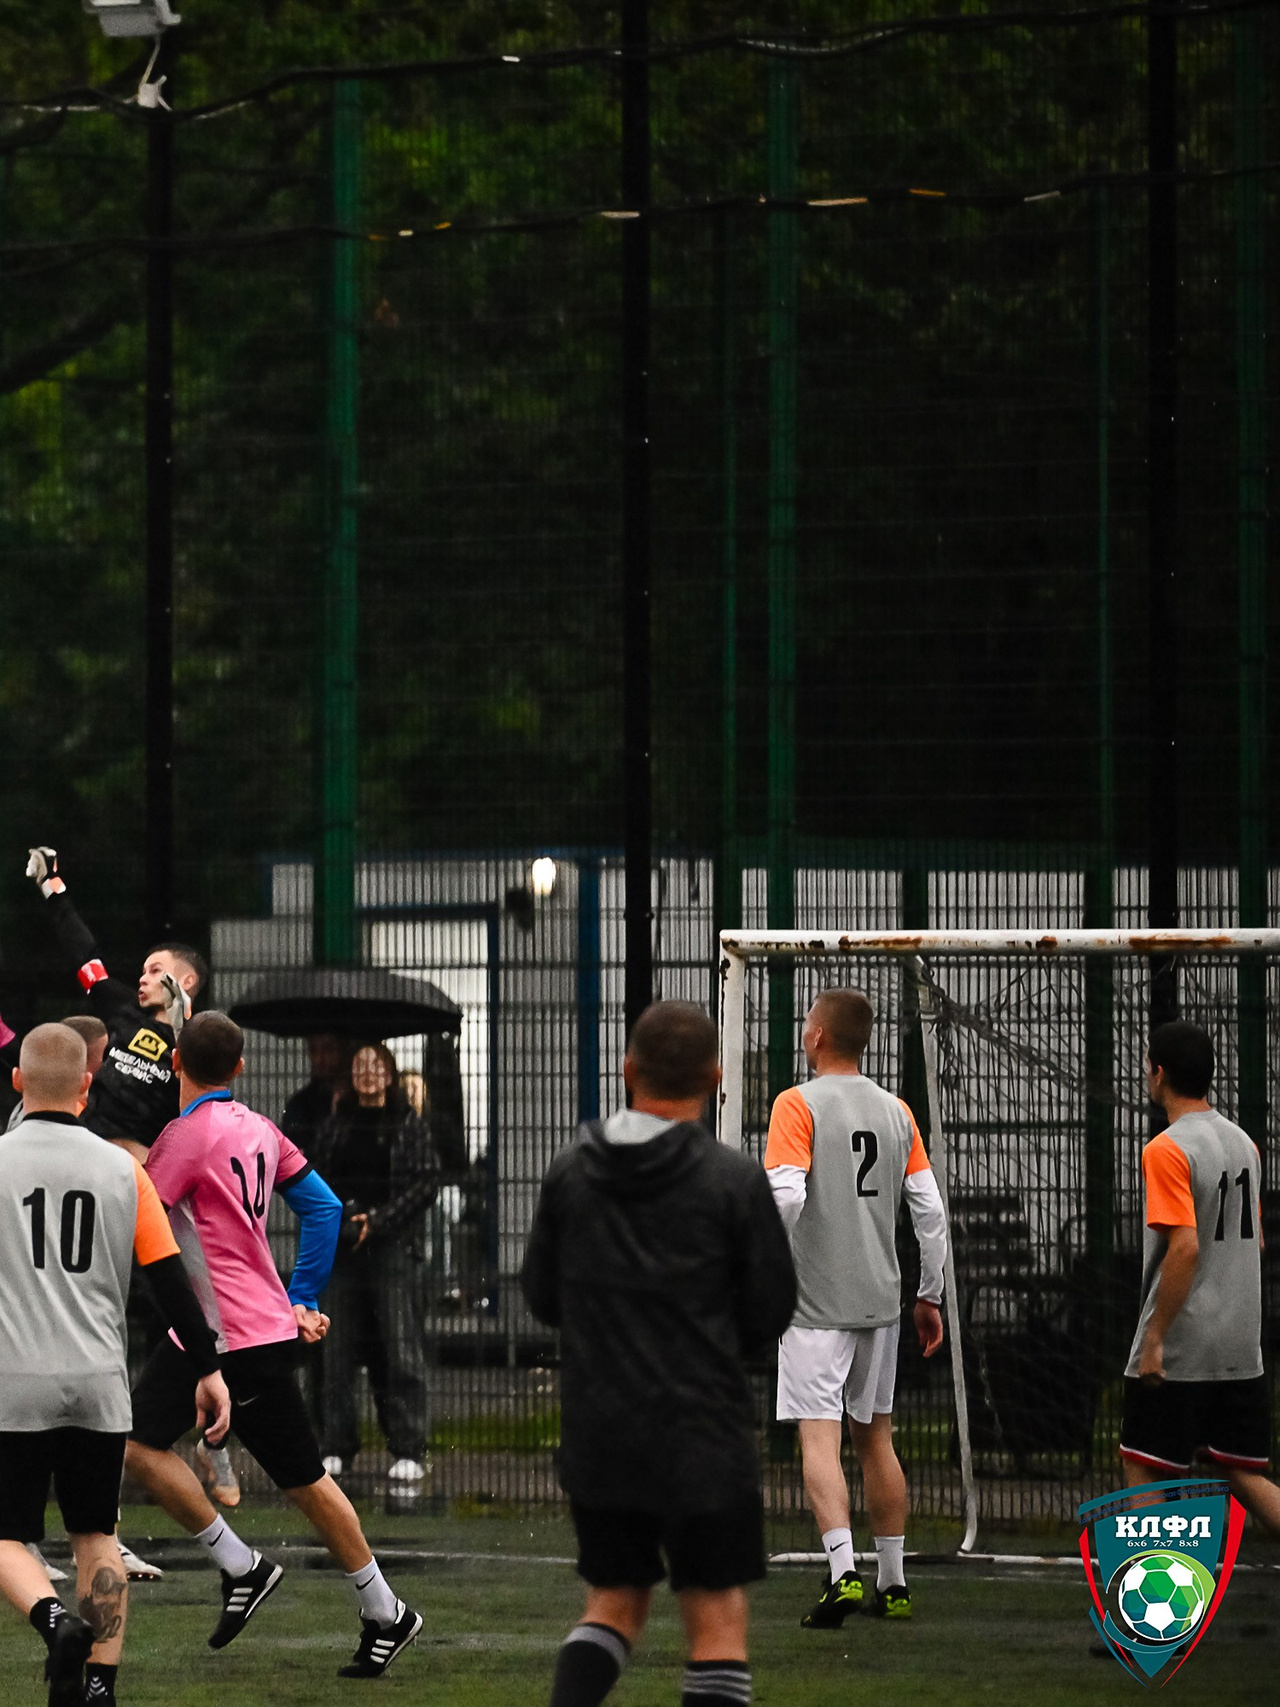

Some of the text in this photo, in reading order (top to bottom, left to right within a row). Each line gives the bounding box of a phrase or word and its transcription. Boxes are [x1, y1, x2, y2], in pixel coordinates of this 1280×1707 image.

[115, 1061, 154, 1084] СЕРВИС
[851, 1130, 879, 1198] 2
[22, 1187, 96, 1274] 10
[1214, 1167, 1255, 1242] 11
